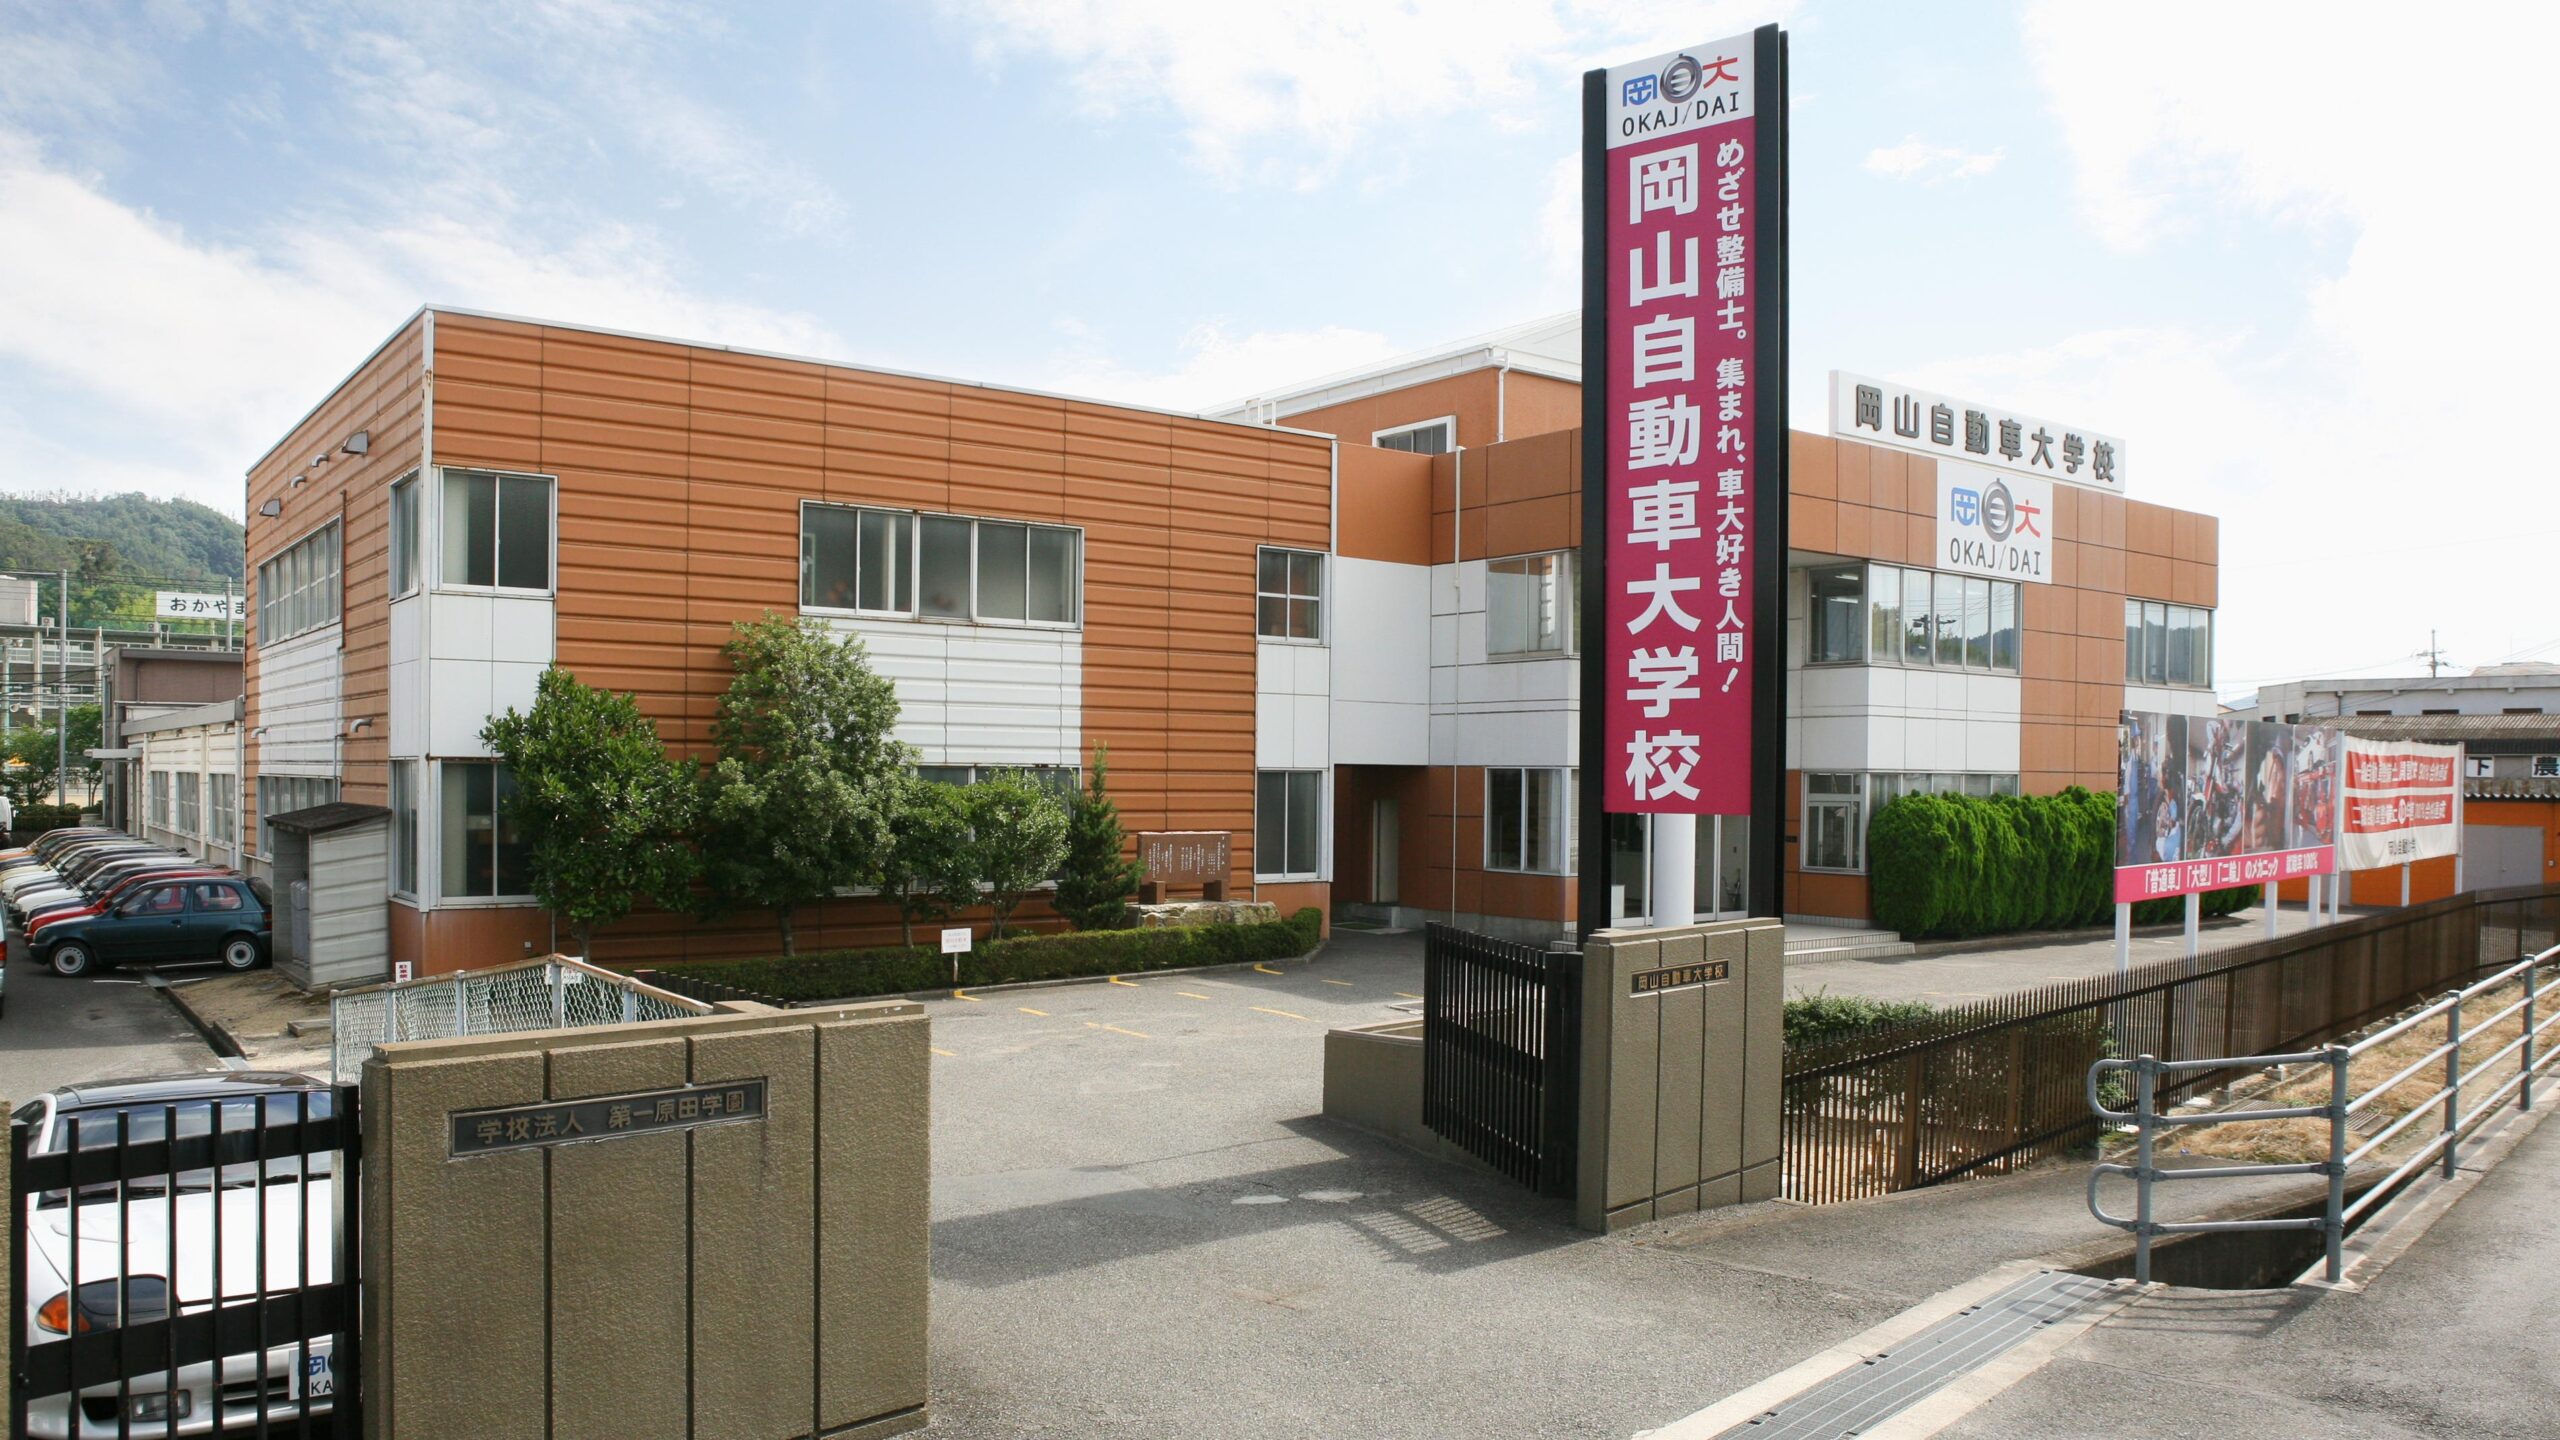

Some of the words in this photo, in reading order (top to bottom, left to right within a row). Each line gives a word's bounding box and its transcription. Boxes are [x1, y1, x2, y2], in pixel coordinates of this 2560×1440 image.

[1625, 142, 1701, 801] 岡山自動車大学校
[1856, 384, 2115, 483] 岡山自動車大学校
[1638, 964, 1724, 991] 岡山自動車大学校
[476, 1111, 584, 1146] 学校法人
[607, 1091, 745, 1129] 第一原田学園
